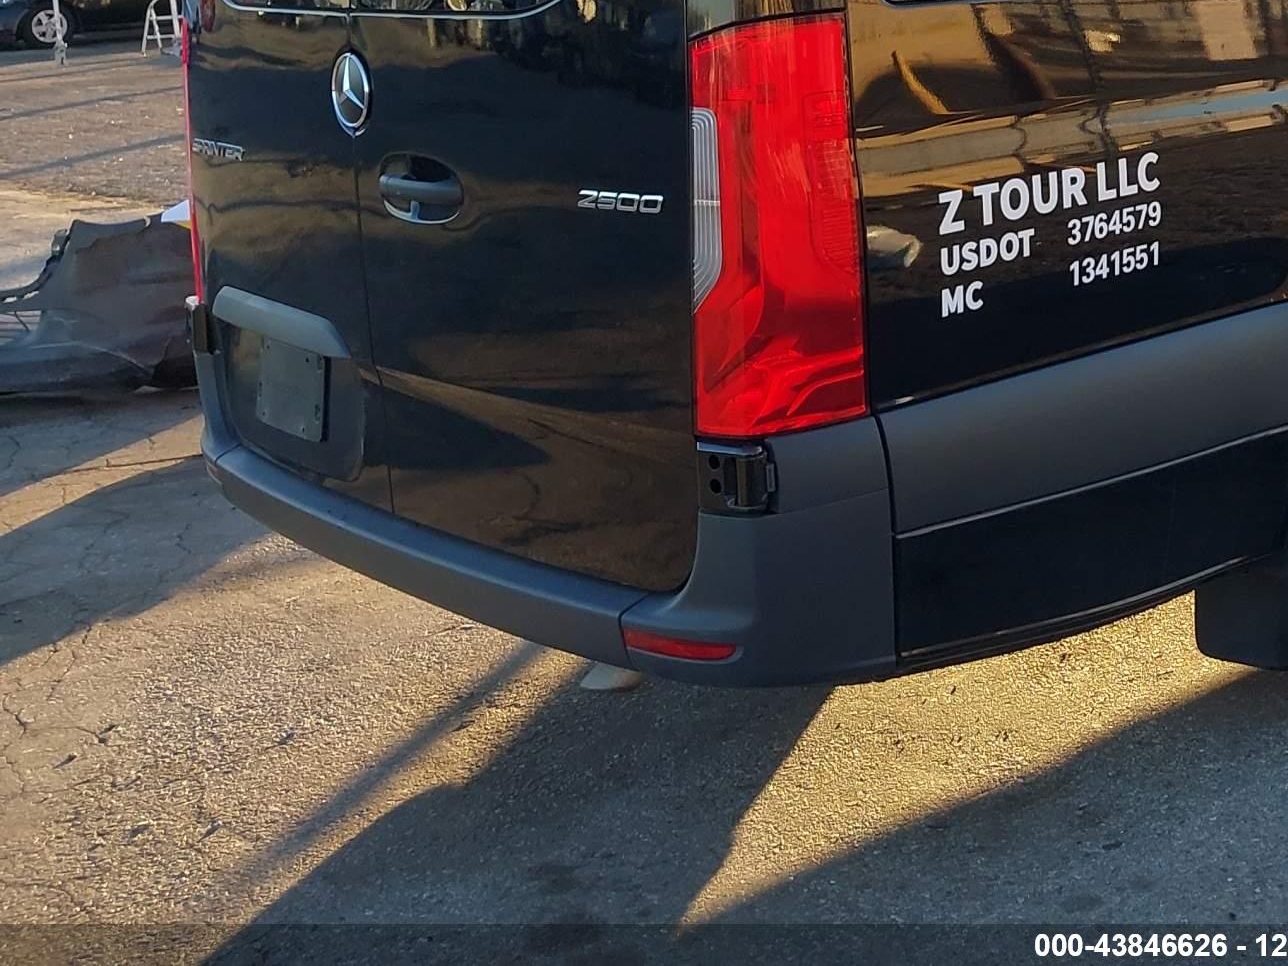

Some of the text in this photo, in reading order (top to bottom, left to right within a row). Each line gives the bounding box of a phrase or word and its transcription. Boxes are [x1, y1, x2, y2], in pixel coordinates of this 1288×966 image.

[577, 189, 664, 214] 2500
[938, 152, 1160, 235] Z TOUR LLC
[940, 202, 1161, 276] USDOT 3764579
[941, 241, 1159, 318] MC 1341551
